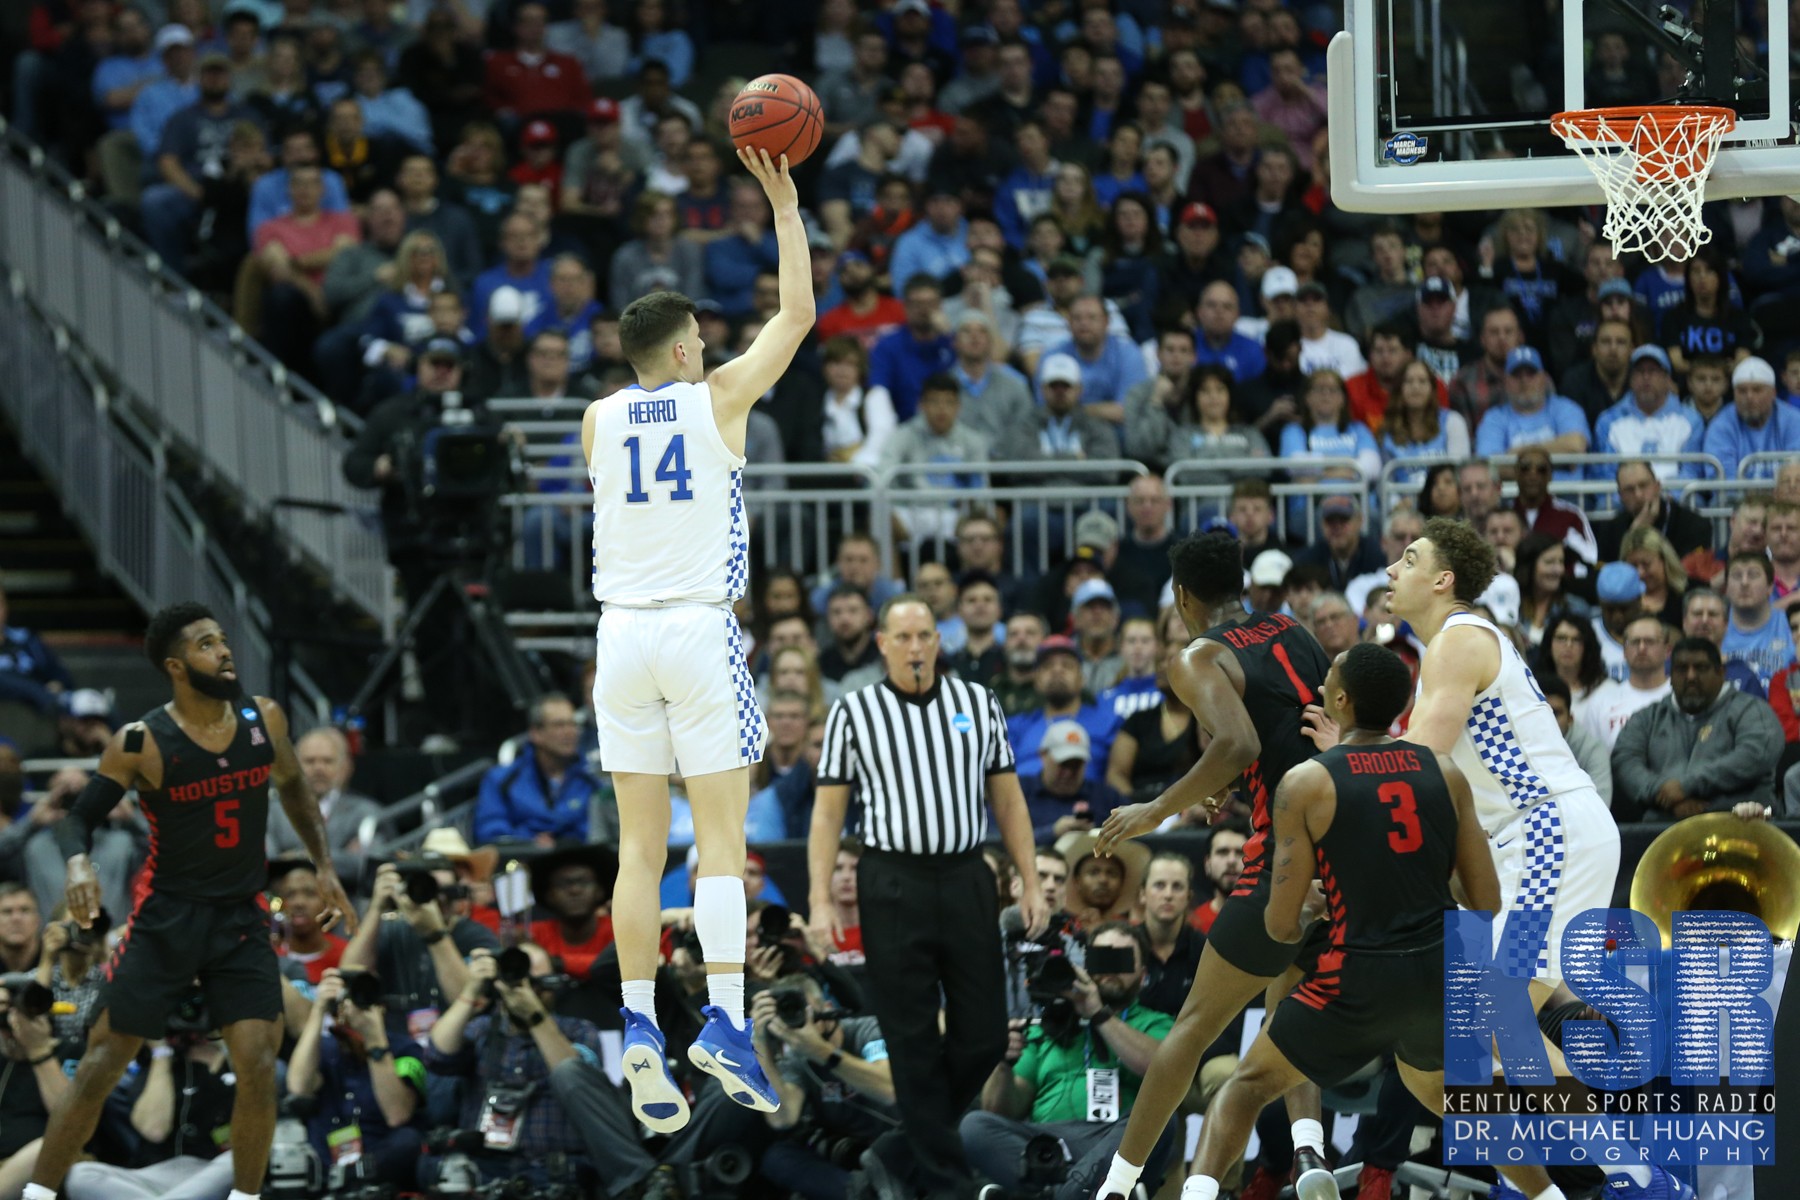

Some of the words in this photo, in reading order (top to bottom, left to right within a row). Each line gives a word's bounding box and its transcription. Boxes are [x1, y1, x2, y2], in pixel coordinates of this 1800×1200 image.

[731, 102, 763, 123] NCAA
[1394, 140, 1416, 149] MARCH
[1396, 146, 1426, 156] MADNESS
[628, 399, 677, 424] HERRO
[623, 434, 693, 503] 14
[1272, 642, 1314, 705] 1
[1346, 751, 1422, 774] BROOKS
[214, 799, 241, 849] 5
[1377, 781, 1424, 854] 3
